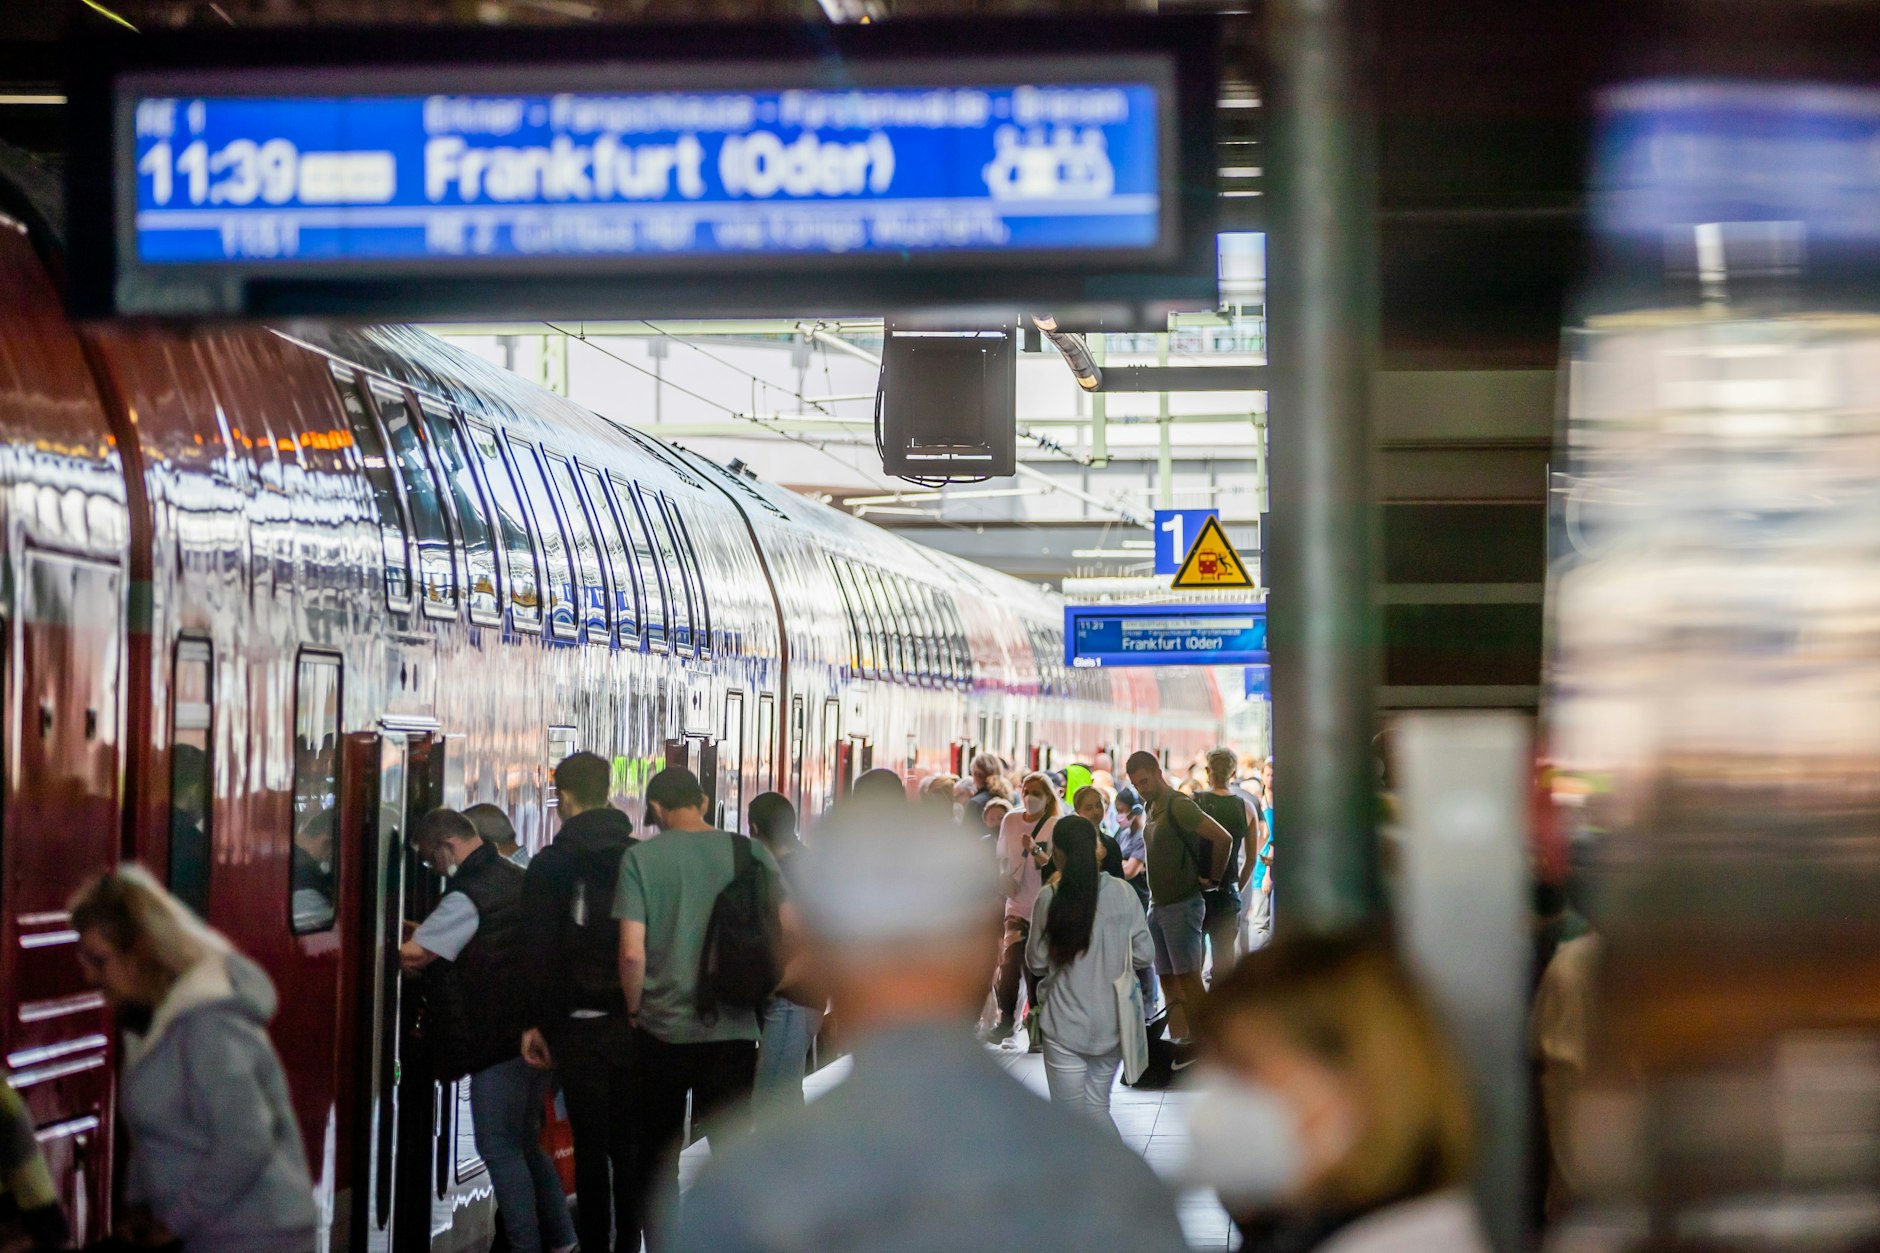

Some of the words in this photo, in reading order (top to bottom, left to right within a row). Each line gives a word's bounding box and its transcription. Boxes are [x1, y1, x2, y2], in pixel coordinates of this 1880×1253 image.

[138, 138, 298, 205] 11:39
[424, 134, 705, 202] Frankfurt
[719, 130, 895, 198] (Oder)
[1161, 514, 1184, 565] 1
[1122, 637, 1181, 651] Frankfurt
[1185, 636, 1223, 650] (Oder)
